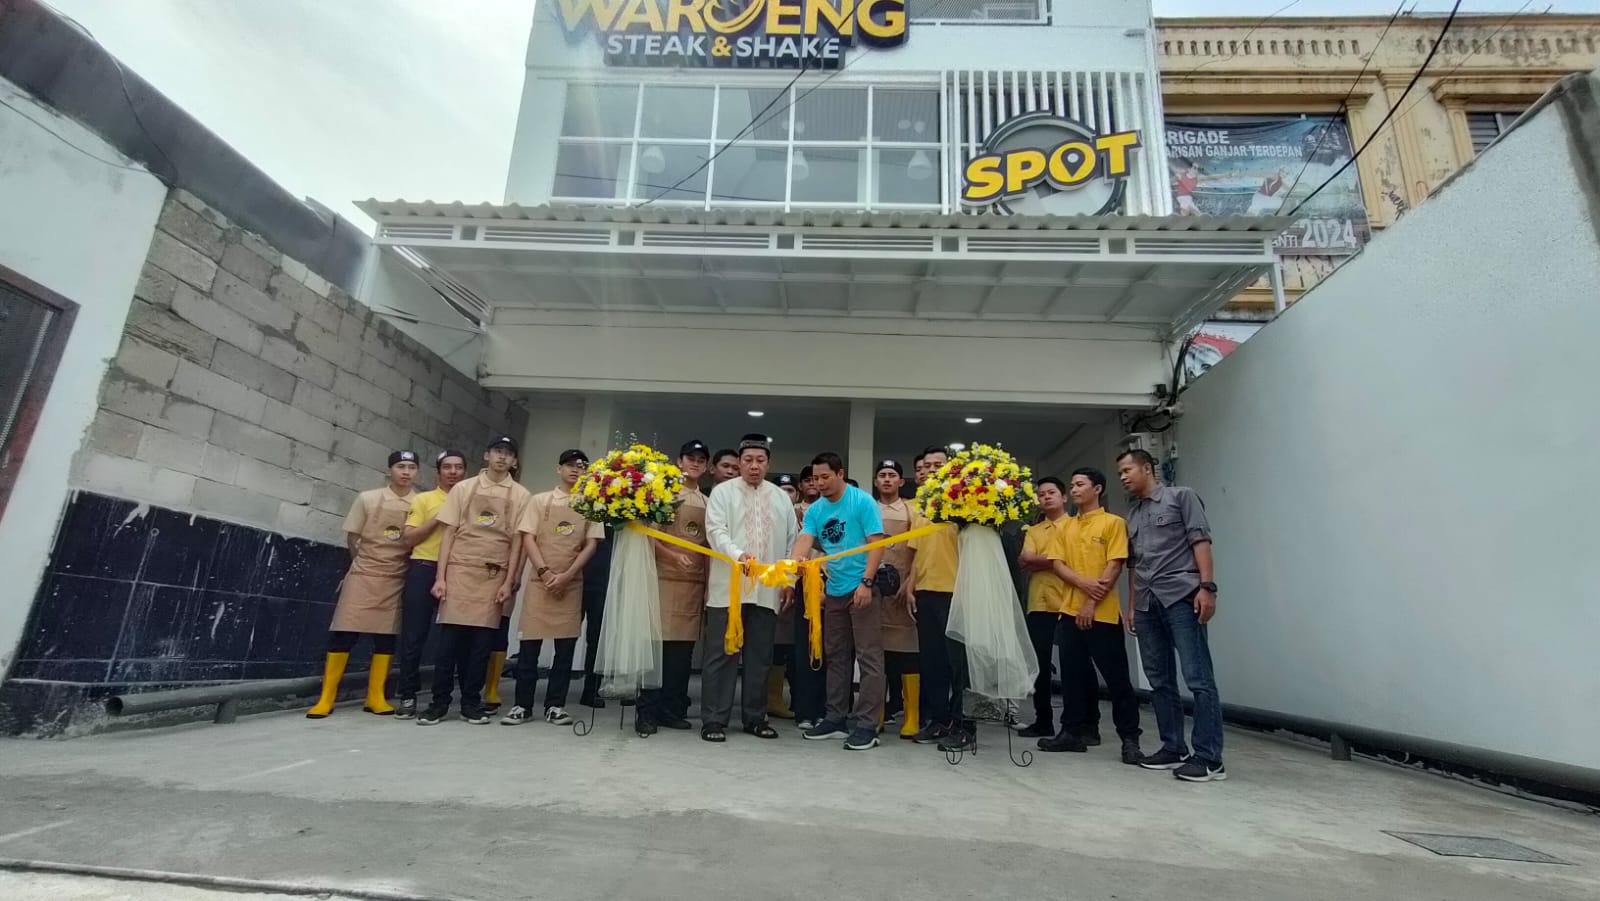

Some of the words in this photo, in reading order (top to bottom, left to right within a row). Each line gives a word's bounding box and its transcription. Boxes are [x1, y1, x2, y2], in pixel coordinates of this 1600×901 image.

[607, 34, 706, 56] STEAK
[711, 36, 732, 57] &
[735, 36, 840, 59] SHAKE
[1164, 130, 1230, 145] RIGADE
[965, 132, 1138, 199] SPOT
[1301, 218, 1357, 248] 2024
